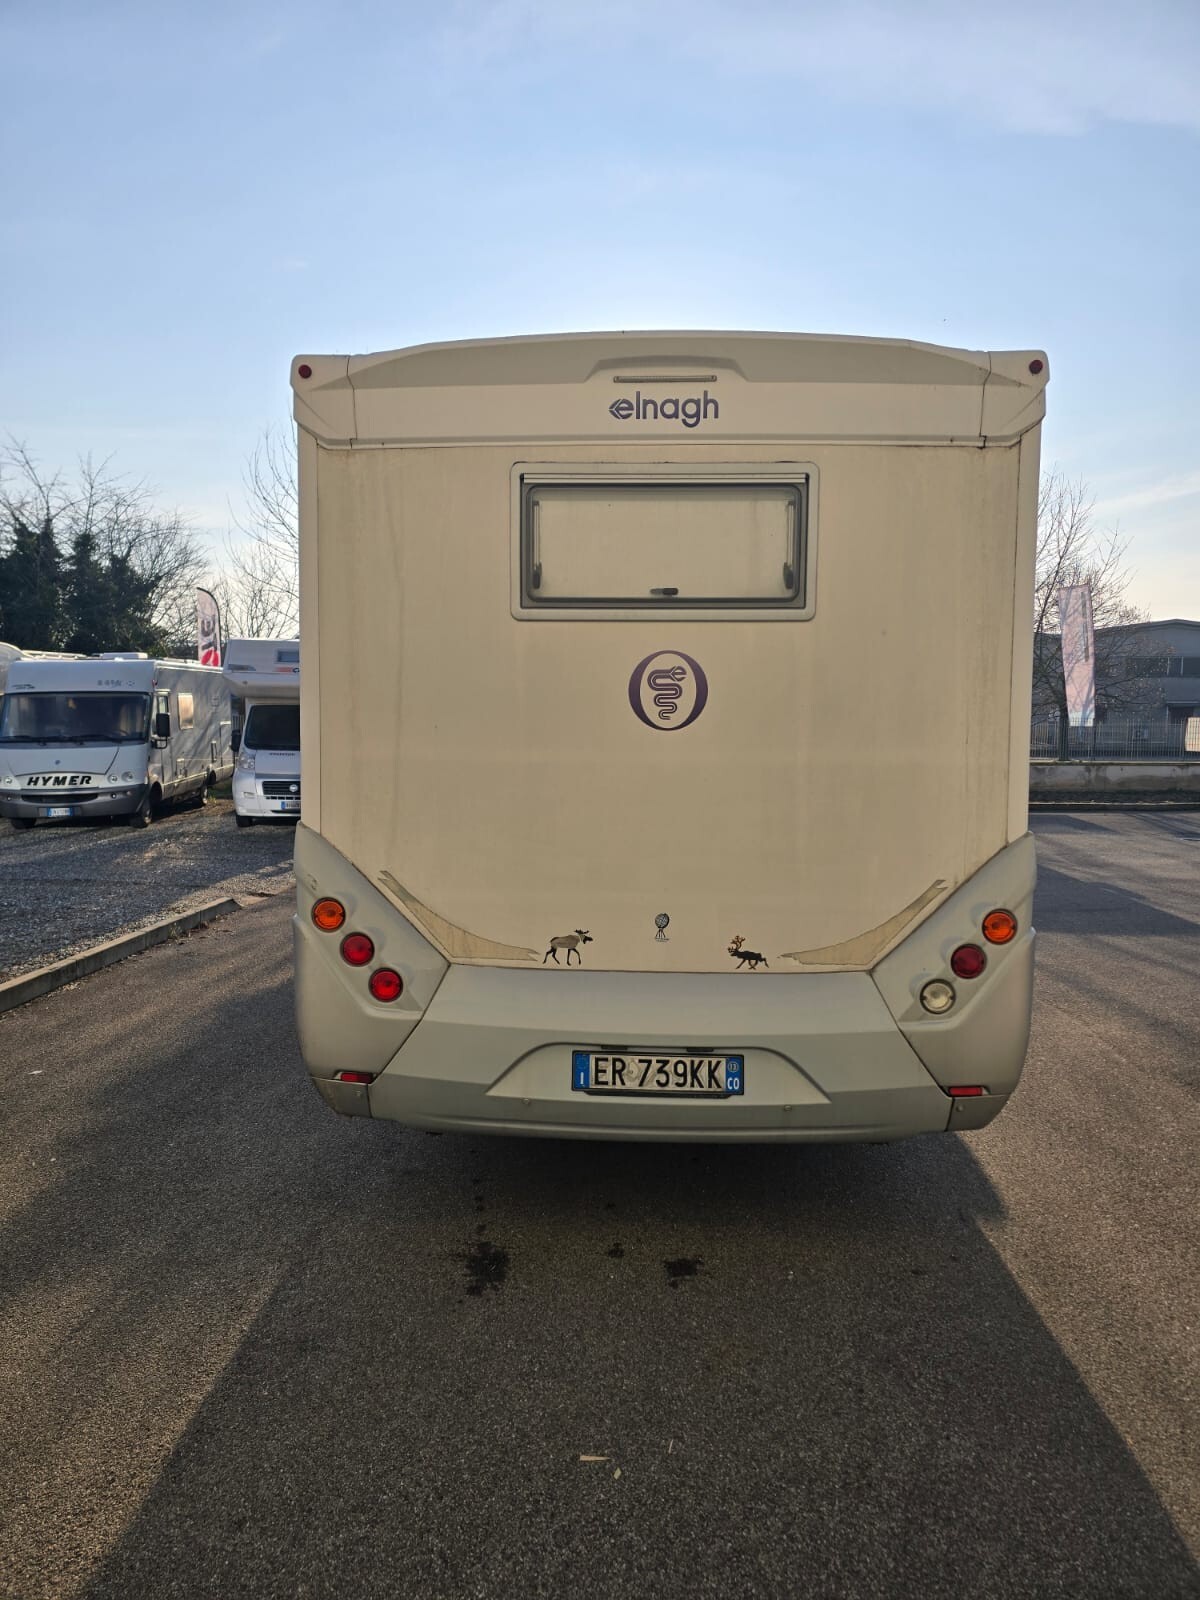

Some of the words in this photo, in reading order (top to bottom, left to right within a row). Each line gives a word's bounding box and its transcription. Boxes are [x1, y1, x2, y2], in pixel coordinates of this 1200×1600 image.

[609, 390, 719, 428] elnagh
[26, 775, 92, 787] HYMER
[727, 1077, 740, 1090] CO
